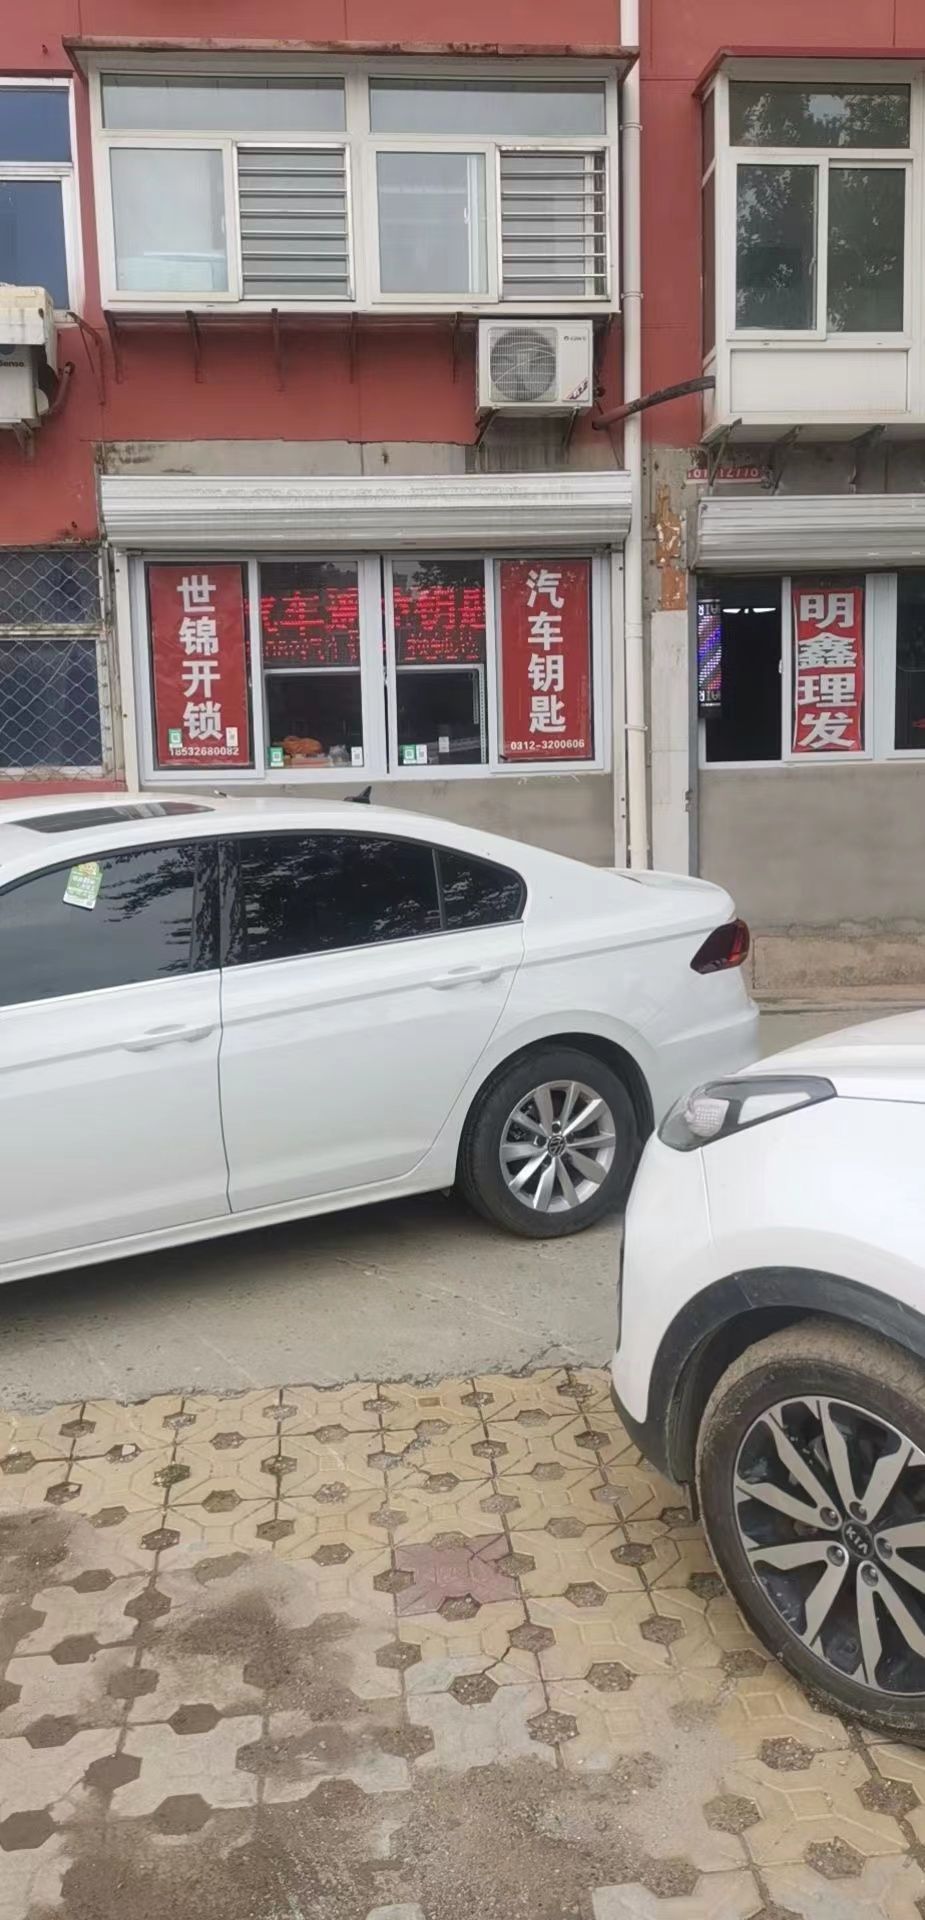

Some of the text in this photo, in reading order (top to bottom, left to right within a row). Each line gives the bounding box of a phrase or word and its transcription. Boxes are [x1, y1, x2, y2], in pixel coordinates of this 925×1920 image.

[177, 574, 223, 740] 世锦开锁
[525, 569, 566, 734] 汽车钥匙
[798, 593, 857, 749] 明鑫理发
[170, 746, 239, 756] 18532680082
[511, 739, 585, 750] 0312-3200606
[846, 1526, 868, 1554] KIA
